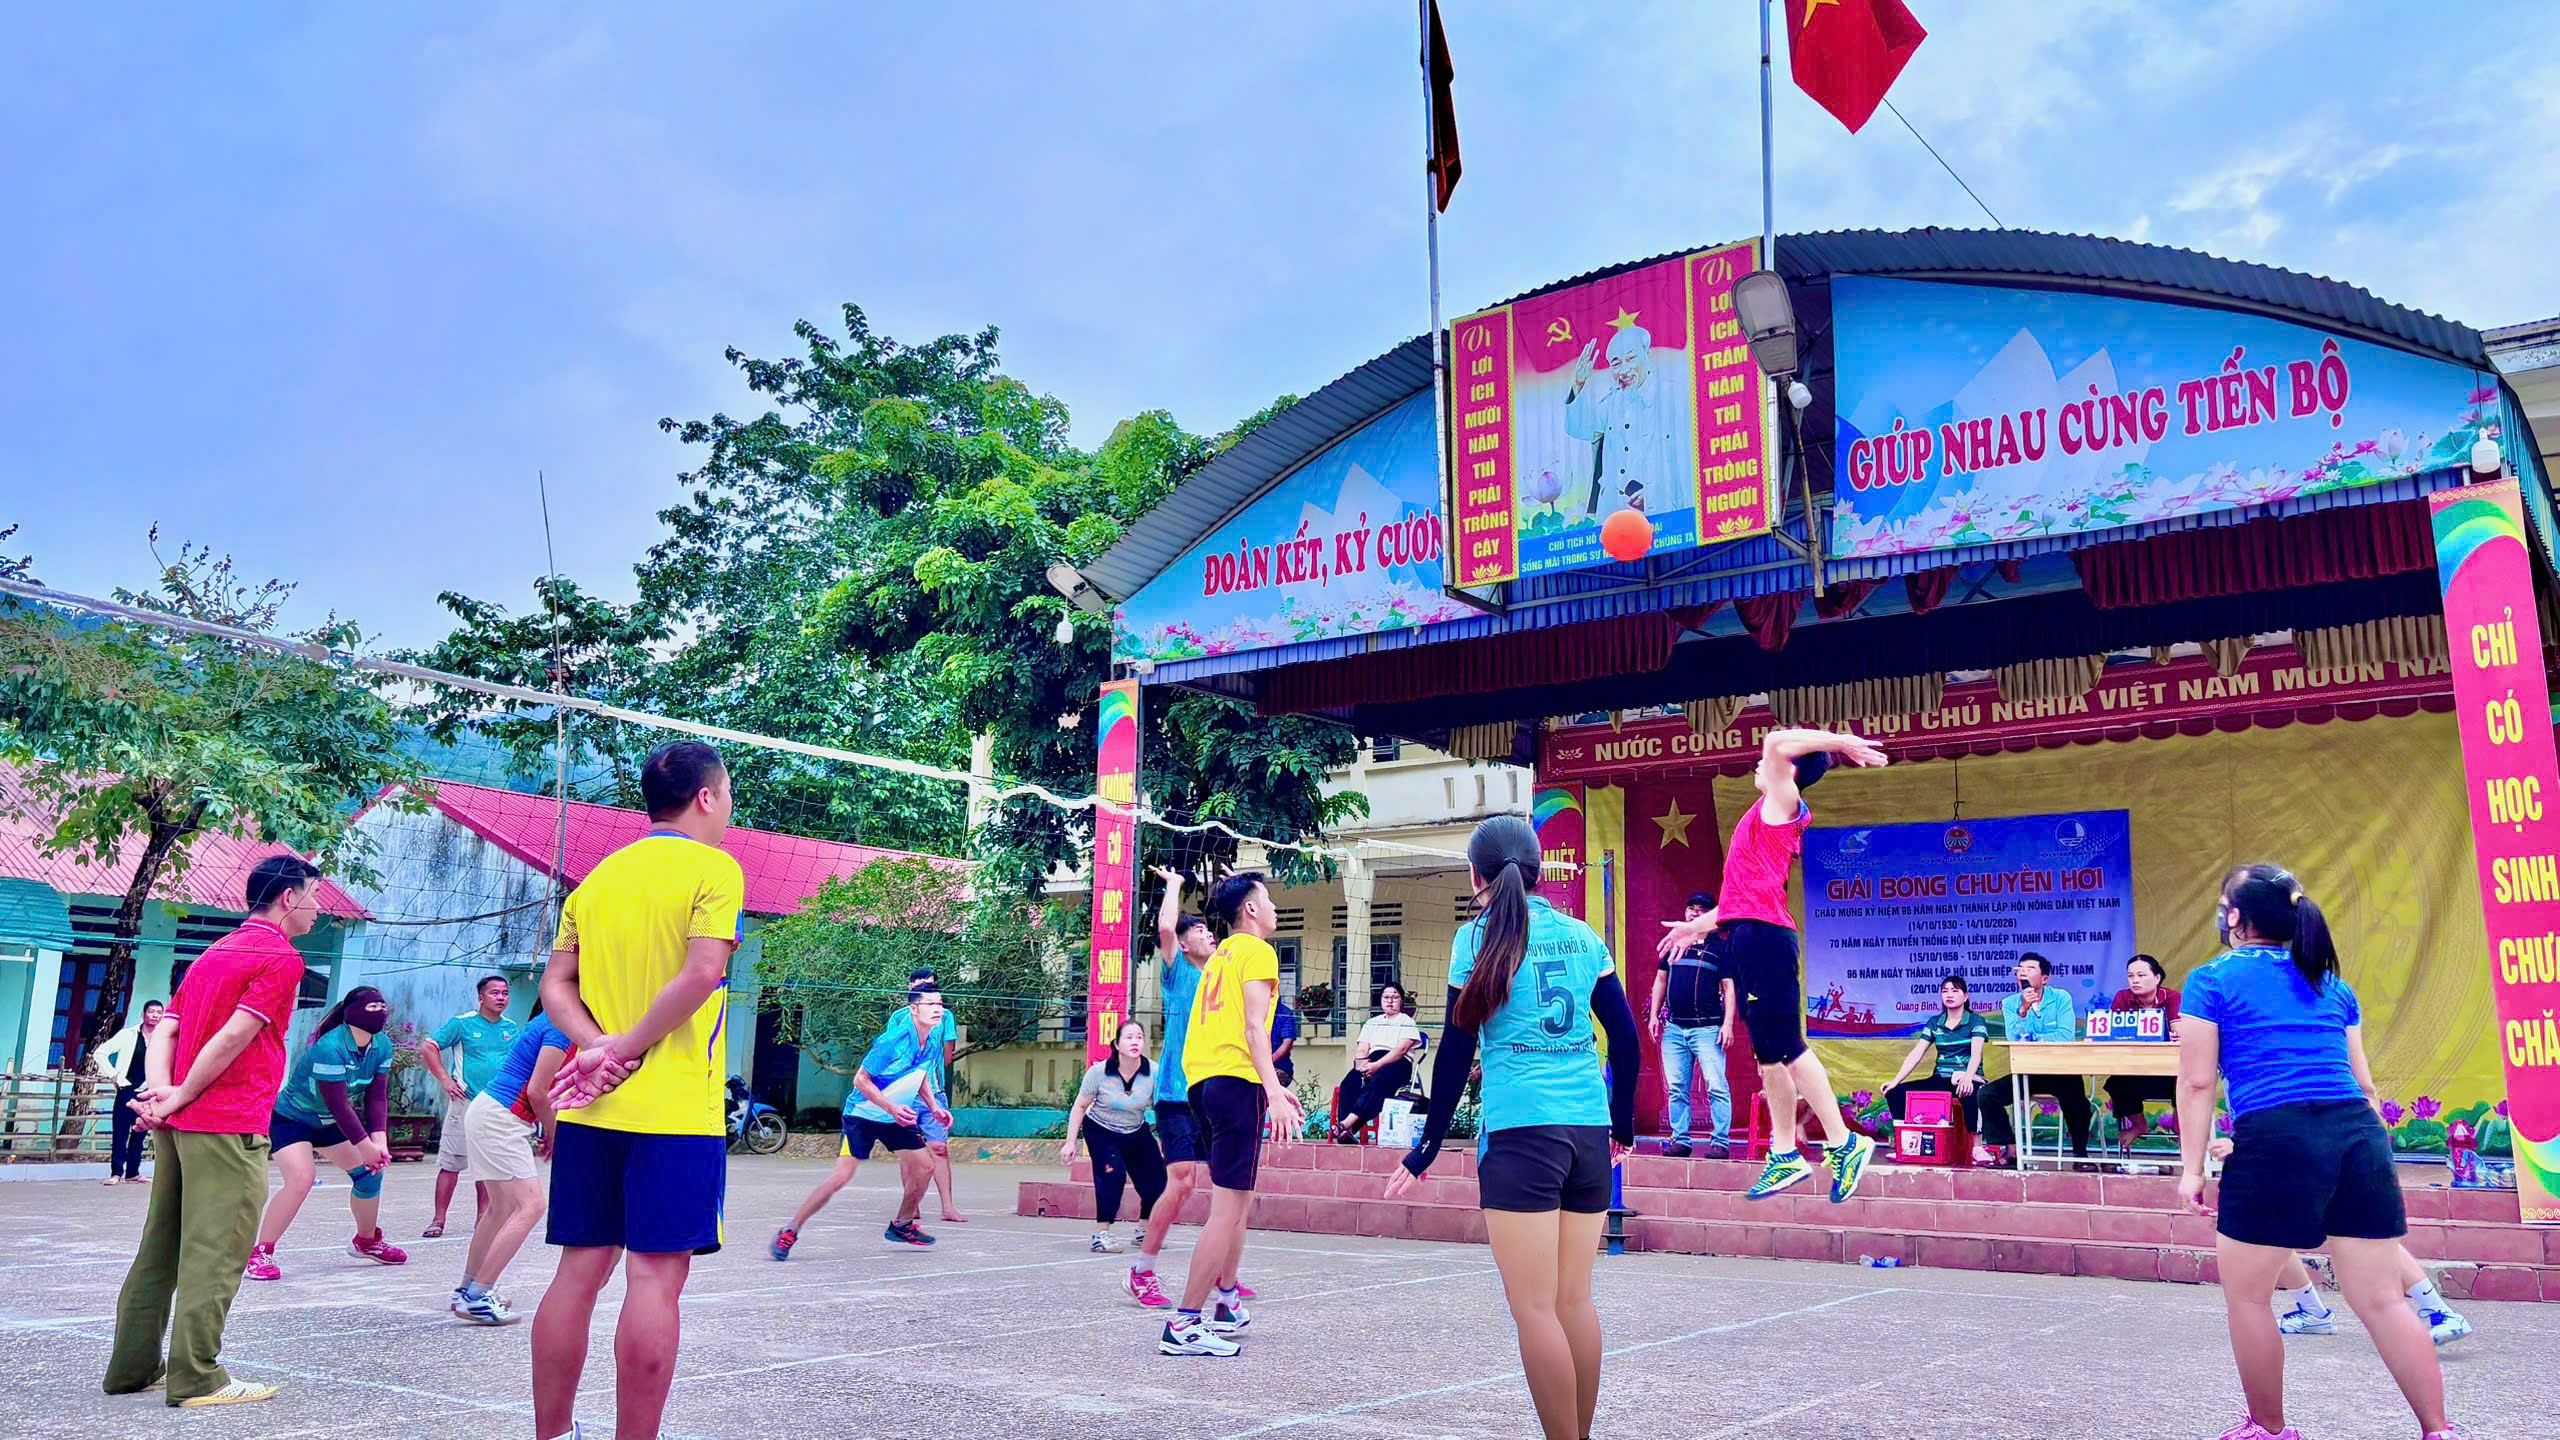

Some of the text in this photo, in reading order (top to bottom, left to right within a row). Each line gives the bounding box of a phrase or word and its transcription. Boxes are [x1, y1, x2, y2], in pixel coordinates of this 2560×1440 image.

[1710, 318, 1738, 341] ÍCH
[1472, 355, 1492, 376] LỢI
[1702, 344, 1748, 371] TRĂM
[1471, 381, 1495, 402] ÍCH
[1709, 374, 1744, 399] NĂM
[1465, 405, 1501, 429] MƯỜI
[1714, 401, 1741, 426] THÌ
[1847, 337, 2350, 493] GIÚP NHAU CÙNG TIẾN BỘ
[1469, 433, 1499, 454] NĂM
[1710, 428, 1748, 456] PHẢI
[1472, 458, 1496, 480] THÌ
[1702, 458, 1758, 486] TRỒNG
[1469, 483, 1501, 507] PHẢI
[1706, 486, 1758, 514] NGƯỜI
[1463, 509, 1509, 534] TRỒNG
[1203, 537, 1270, 597] ĐOÀN
[1274, 519, 1329, 588] KẾT,
[1334, 511, 1371, 576] KỶ
[1473, 538, 1500, 558] CÂY
[1562, 552, 1588, 566] TRONG
[1685, 532, 1694, 543] TA
[2471, 606, 2518, 669] CHỈ
[1595, 734, 1662, 761] NƯỚC
[1921, 696, 1980, 729] CHỦ
[2098, 680, 2166, 713] VIỆT
[2179, 671, 2259, 701] NAM
[2486, 689, 2523, 745] CÓ
[1101, 767, 1133, 804] KHÔNG
[2486, 775, 2543, 832] HỌC
[1107, 823, 1122, 864] CÓ
[1827, 864, 2104, 901] GIẢI BÓNG CHUYỀN HƠI
[2492, 855, 2560, 904] SINH
[1102, 889, 1123, 931] HỌC
[2010, 900, 2026, 914] HỘI
[2076, 898, 2095, 911] VIỆT
[2098, 898, 2121, 908] NAM
[1580, 940, 1588, 953] 8
[1863, 935, 1885, 948] NGÀY
[1950, 935, 1966, 948] HỘI
[1967, 934, 1987, 945] LIÊN
[1989, 933, 2009, 946] HIỆP
[2012, 933, 2042, 944] THANH
[2043, 932, 2065, 943] NIÊN
[2067, 931, 2087, 944] VIỆT
[2089, 931, 2112, 942] NAM
[1098, 949, 1123, 984] SINH
[1881, 966, 1903, 979] NGÀY
[1971, 966, 1990, 977] LIÊN
[1992, 965, 2012, 978] HIỆP
[2072, 964, 2094, 975] NAM
[2500, 932, 2560, 985] CHƯ
[1533, 960, 1575, 1039] 5
[2089, 1017, 2108, 1034] 13
[2140, 1016, 2159, 1034] 16
[2506, 1008, 2560, 1068] CHĂ
